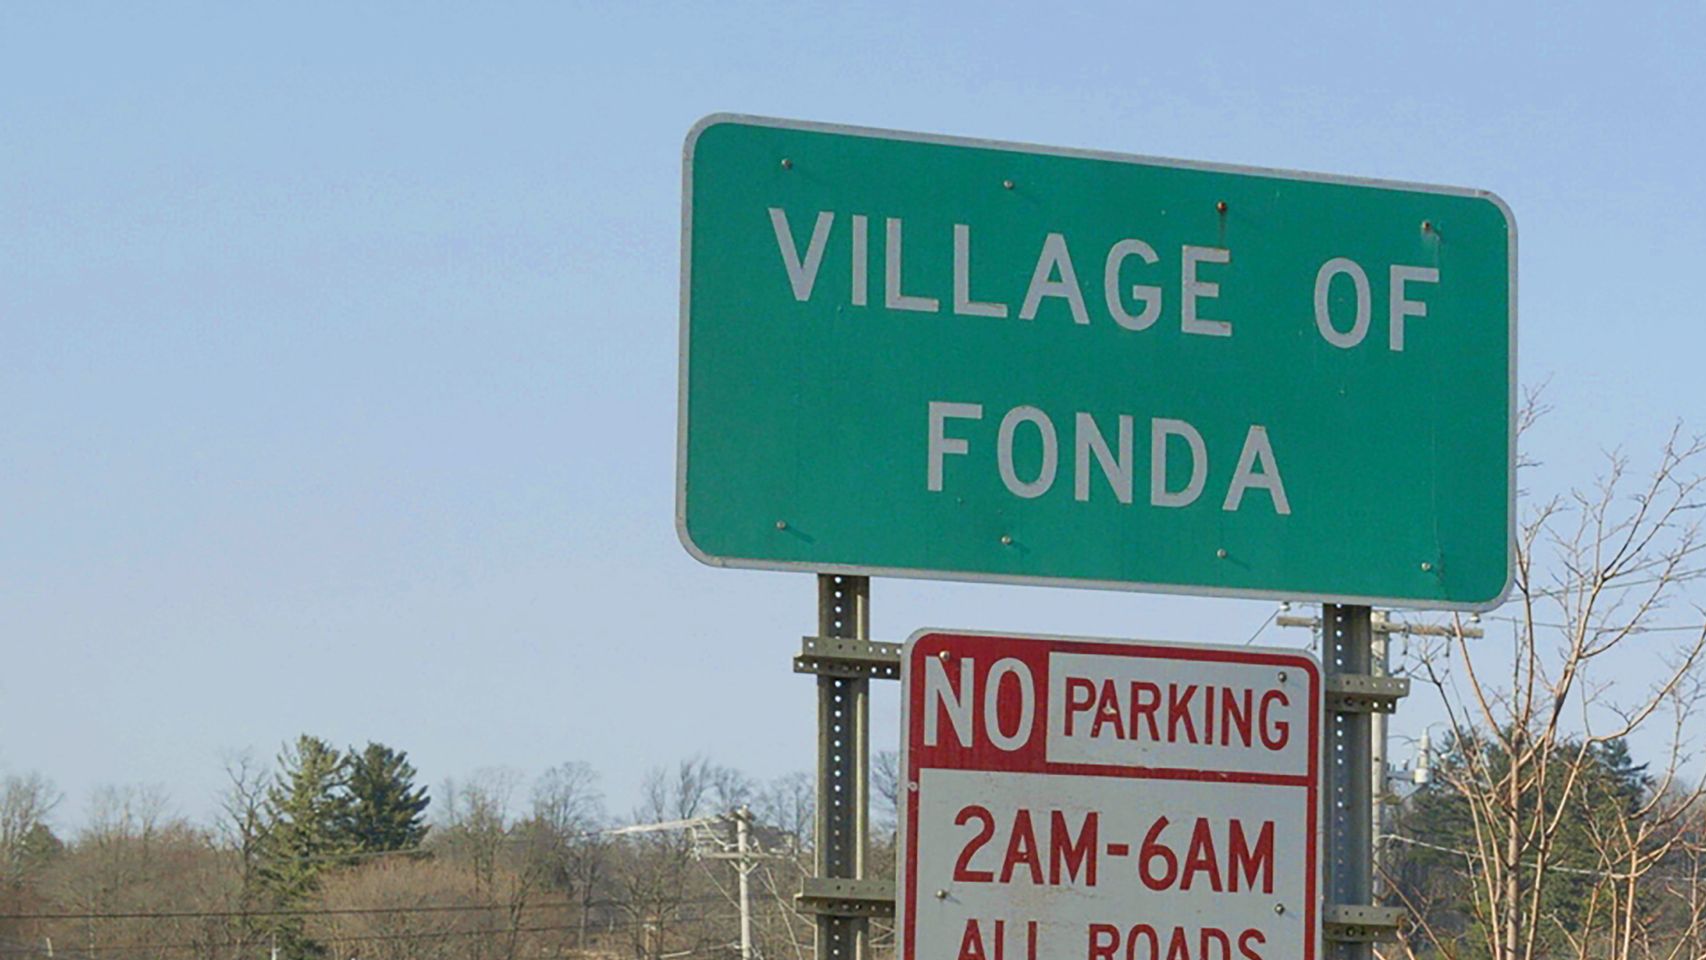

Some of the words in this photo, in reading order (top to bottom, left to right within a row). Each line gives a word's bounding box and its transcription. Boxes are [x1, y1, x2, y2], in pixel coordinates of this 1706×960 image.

[768, 207, 1232, 338] VILLAGE
[1314, 256, 1439, 352] OF
[927, 400, 1291, 515] FONDA
[923, 656, 1036, 752] NO
[1063, 676, 1290, 752] PARKING
[952, 804, 1275, 895] 2AM-6AM
